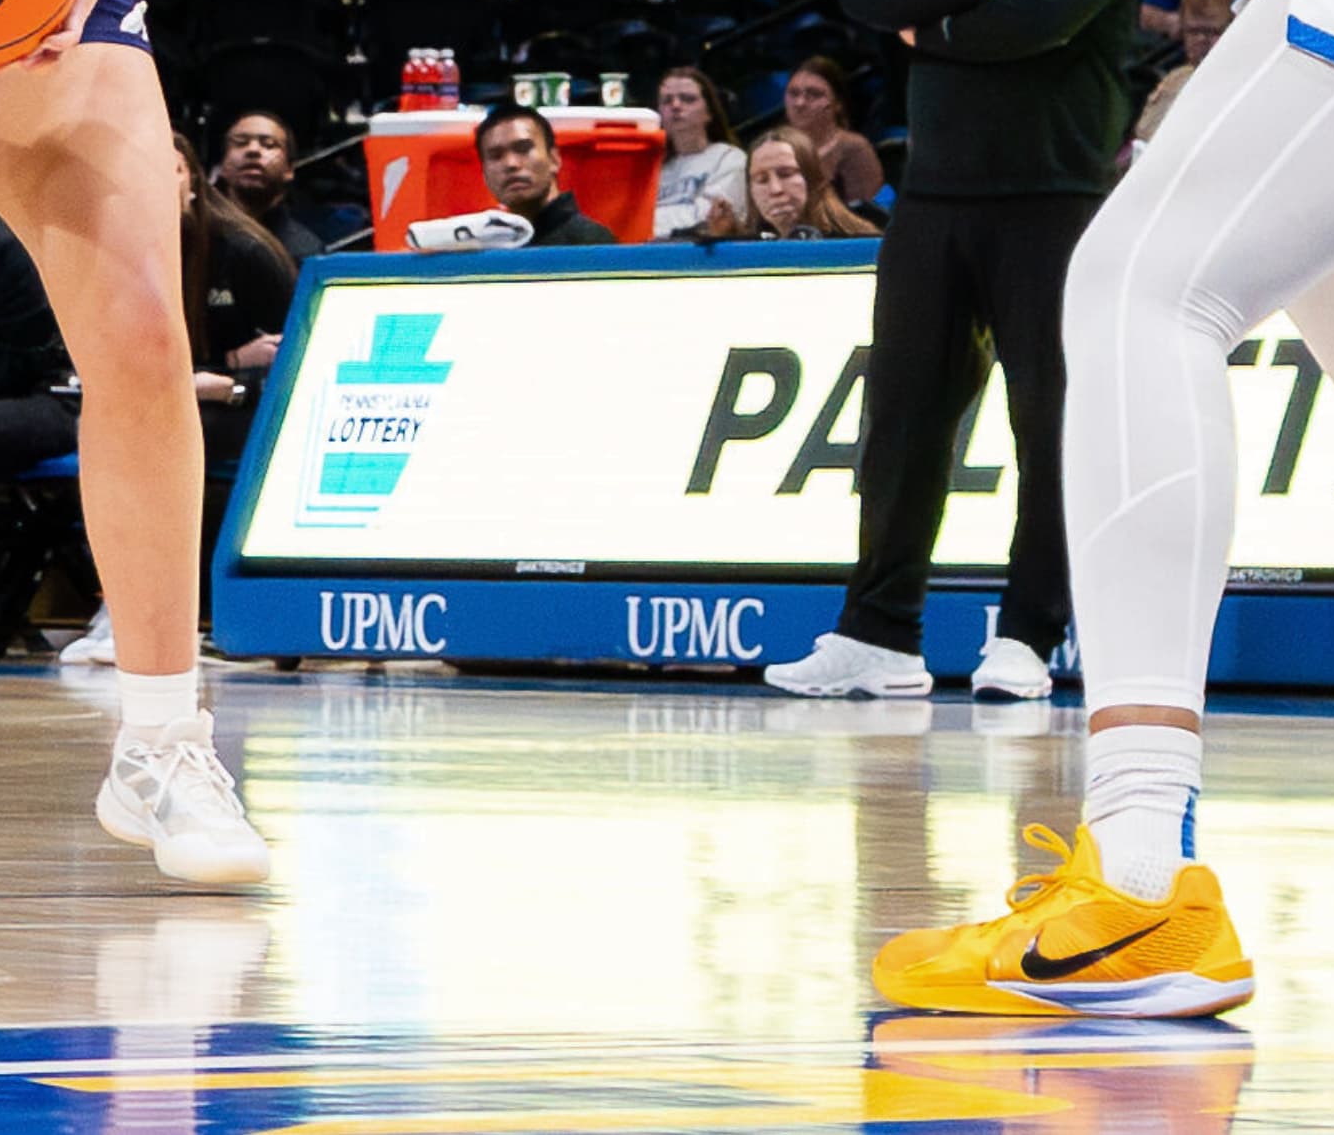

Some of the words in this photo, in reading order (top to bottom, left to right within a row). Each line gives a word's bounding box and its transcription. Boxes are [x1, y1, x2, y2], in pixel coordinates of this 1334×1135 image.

[327, 416, 425, 443] LOTTERY
[319, 591, 447, 653] UPMC
[625, 595, 765, 660] UPMC
